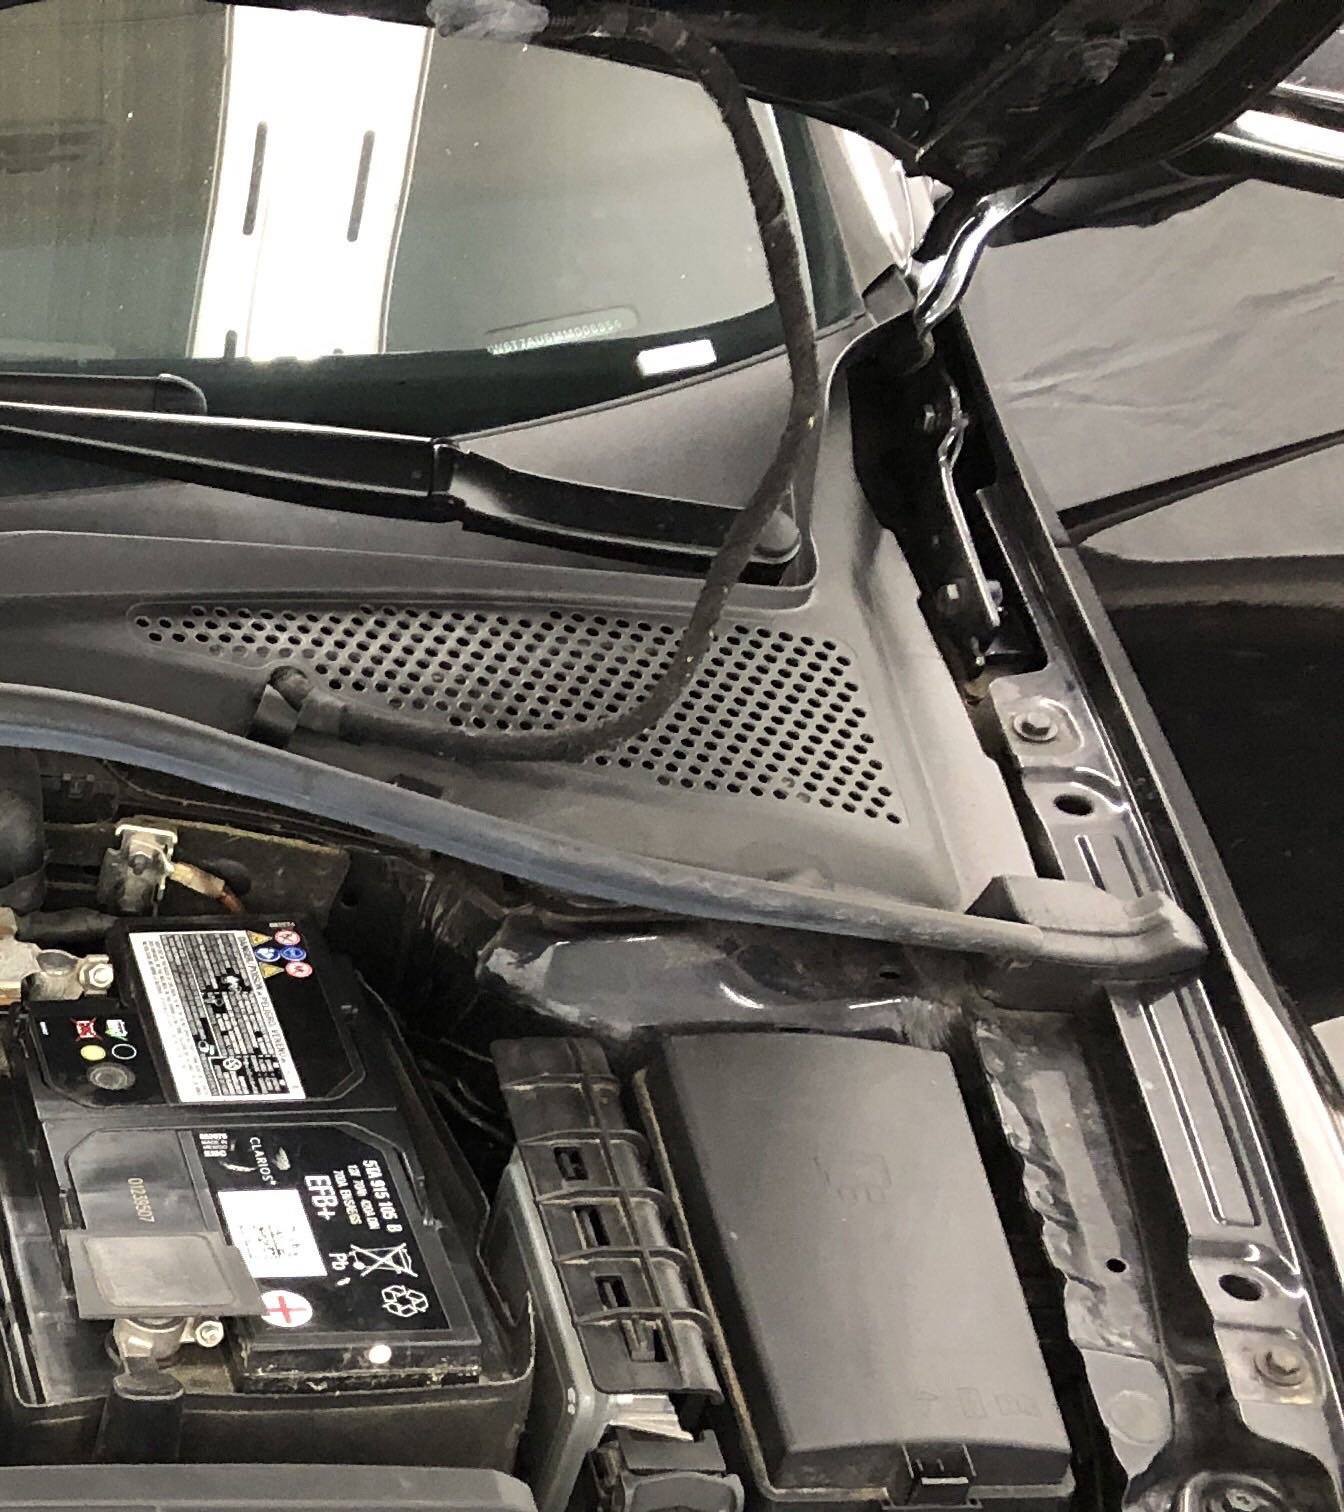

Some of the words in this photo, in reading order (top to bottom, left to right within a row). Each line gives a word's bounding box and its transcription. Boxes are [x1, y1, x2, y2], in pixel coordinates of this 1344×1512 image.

[362, 1160, 382, 1179] 5TA
[304, 1175, 339, 1220] EFB+
[370, 1180, 390, 1199] 915
[329, 1253, 349, 1270] Pb
